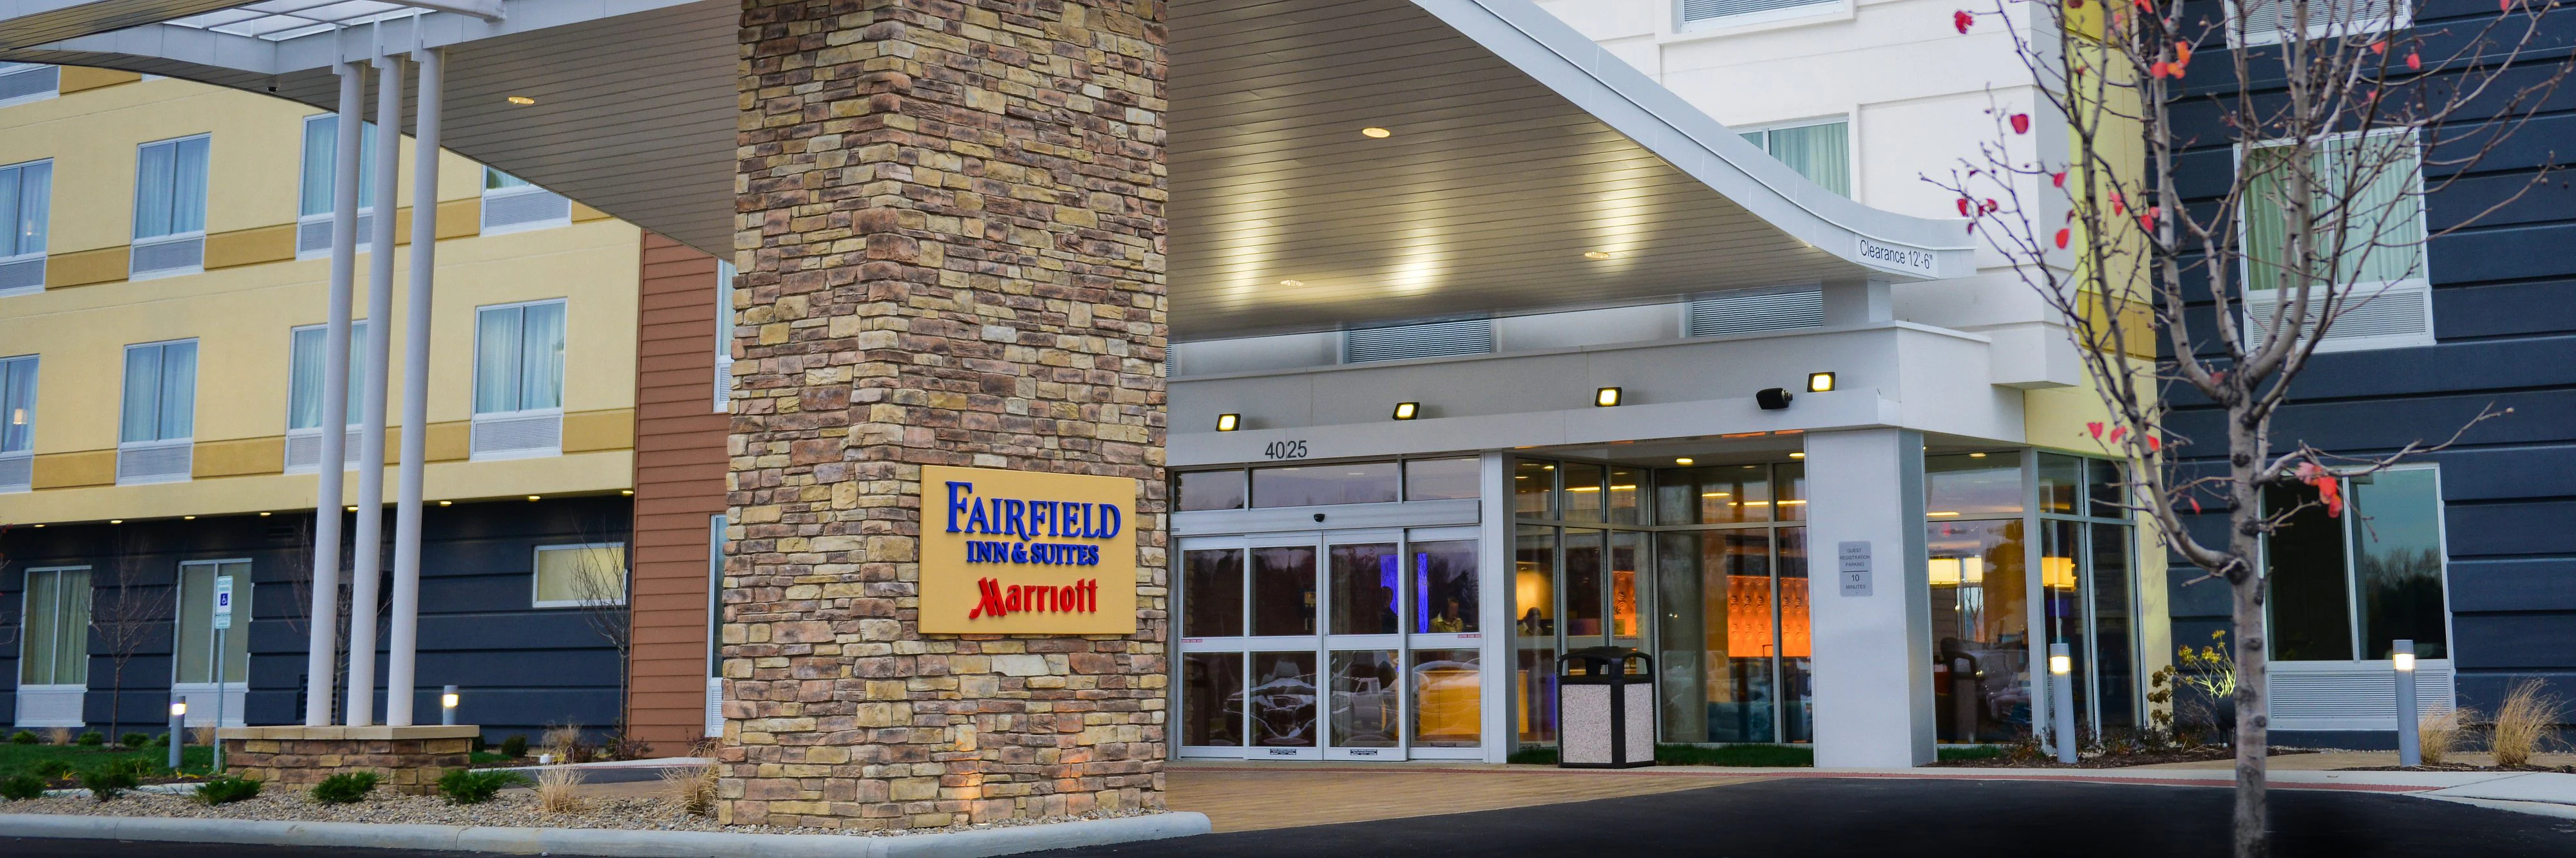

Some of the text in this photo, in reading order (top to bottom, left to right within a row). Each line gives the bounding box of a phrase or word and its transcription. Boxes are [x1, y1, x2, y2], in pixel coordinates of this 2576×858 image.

[1860, 239, 1905, 264] Clearance
[1265, 440, 1307, 459] 4025
[945, 481, 1121, 541] FAIRFIELD
[967, 541, 1099, 565] INN & SUITES
[969, 577, 1098, 619] Marriott
